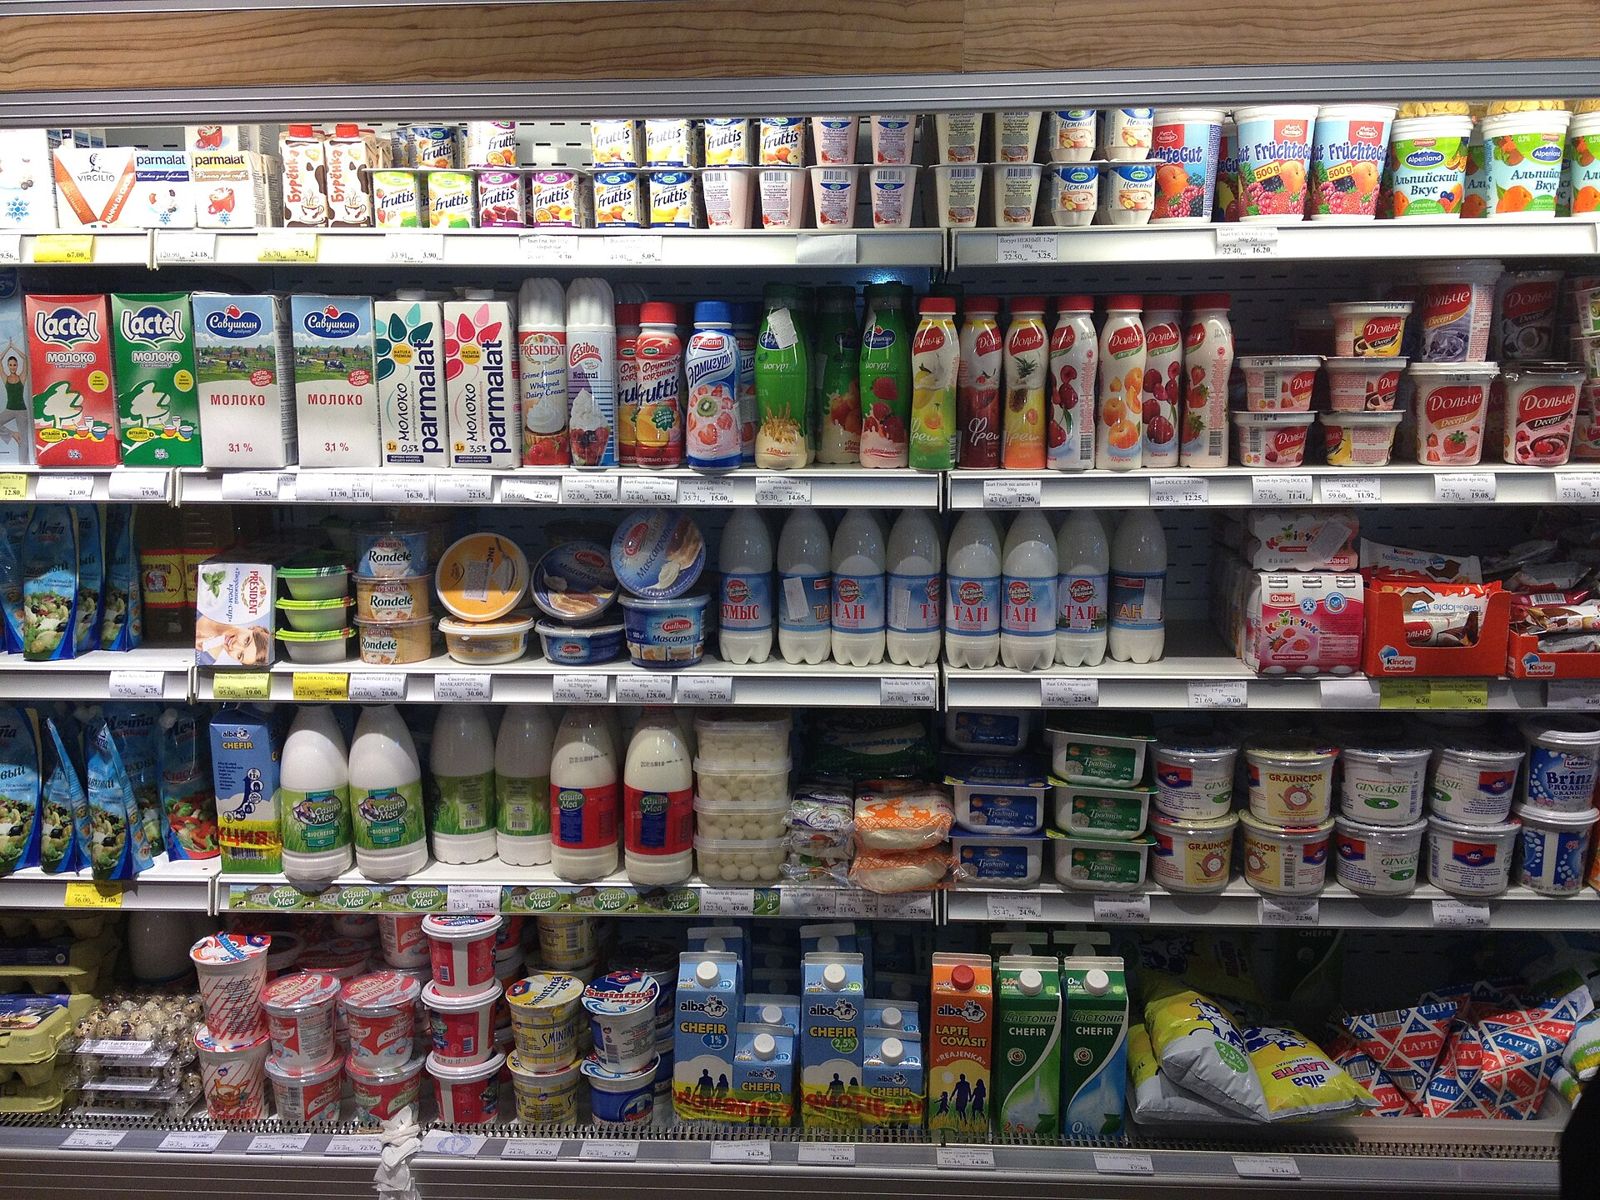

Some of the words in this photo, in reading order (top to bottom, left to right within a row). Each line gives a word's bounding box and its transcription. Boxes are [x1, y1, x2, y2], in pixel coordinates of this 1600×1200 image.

[707, 130, 742, 149] fruttis
[764, 132, 799, 149] fruttis
[137, 153, 186, 166] parmalat
[195, 154, 245, 167] parmalat
[1408, 154, 1441, 163] Alpenland
[77, 173, 115, 182] VIRGILIO
[1395, 173, 1458, 185] Альпийский
[1411, 186, 1438, 195] Вкус
[381, 191, 414, 208] fruttis
[435, 194, 469, 211] fruttis
[480, 190, 515, 207] fruttis
[535, 190, 570, 207] fruttis
[598, 190, 632, 207] fruttis
[653, 189, 688, 207] fruttis
[36, 312, 99, 342] lactel
[122, 312, 185, 342] lactel
[210, 316, 257, 333] Савушкин
[308, 315, 355, 332] Савушкин
[521, 344, 566, 355] PRÉSIDENT
[47, 353, 96, 363] МОЛОКО
[133, 352, 181, 363] МОЛОКО
[413, 339, 443, 453] parmalat
[482, 340, 511, 453] parmalat
[638, 379, 679, 404] fruttis
[211, 394, 266, 406] МОЛОКО
[308, 394, 363, 405] МОЛОКО
[1429, 393, 1481, 411] Дольче
[1523, 393, 1574, 410] Дольче
[1441, 415, 1467, 427] Десерт
[1534, 415, 1561, 427] Десерт
[229, 443, 240, 452] 3,1
[243, 443, 253, 452] %
[325, 443, 337, 451] 3,1
[340, 443, 349, 451] %
[368, 550, 412, 563] Rondelé
[249, 571, 258, 615] PRÉSIDENT
[370, 595, 413, 607] Rondelé
[834, 603, 865, 620] ТАН
[953, 605, 988, 622] ТАН
[1004, 605, 1037, 623] ТАН
[1065, 605, 1097, 620] ТАН
[222, 730, 238, 738] alba
[222, 741, 254, 749] CHEFIR
[680, 1001, 704, 1012] alba
[809, 1006, 834, 1016] alba
[938, 1005, 962, 1016] alba
[1003, 1011, 1058, 1023] LACTONIA
[1071, 1010, 1125, 1022] LACTONIA
[680, 1022, 727, 1035] CHEFIR
[809, 1026, 857, 1039] CHEFIR
[936, 1025, 968, 1036] LAPTE
[1008, 1027, 1047, 1036] CHEFIR
[1075, 1027, 1114, 1036] CHEFIR
[710, 1036, 722, 1045] 1%
[940, 1036, 987, 1047] COVASIT
[1403, 1039, 1441, 1053] LAPTE
[1497, 1036, 1538, 1055] LAPTE
[748, 1069, 764, 1078] alba
[1271, 1061, 1330, 1080] LAPTE
[877, 1075, 893, 1083] alba
[1292, 1074, 1326, 1088] alba
[741, 1082, 782, 1092] CHEFIR
[871, 1087, 911, 1097] CHEFIR
